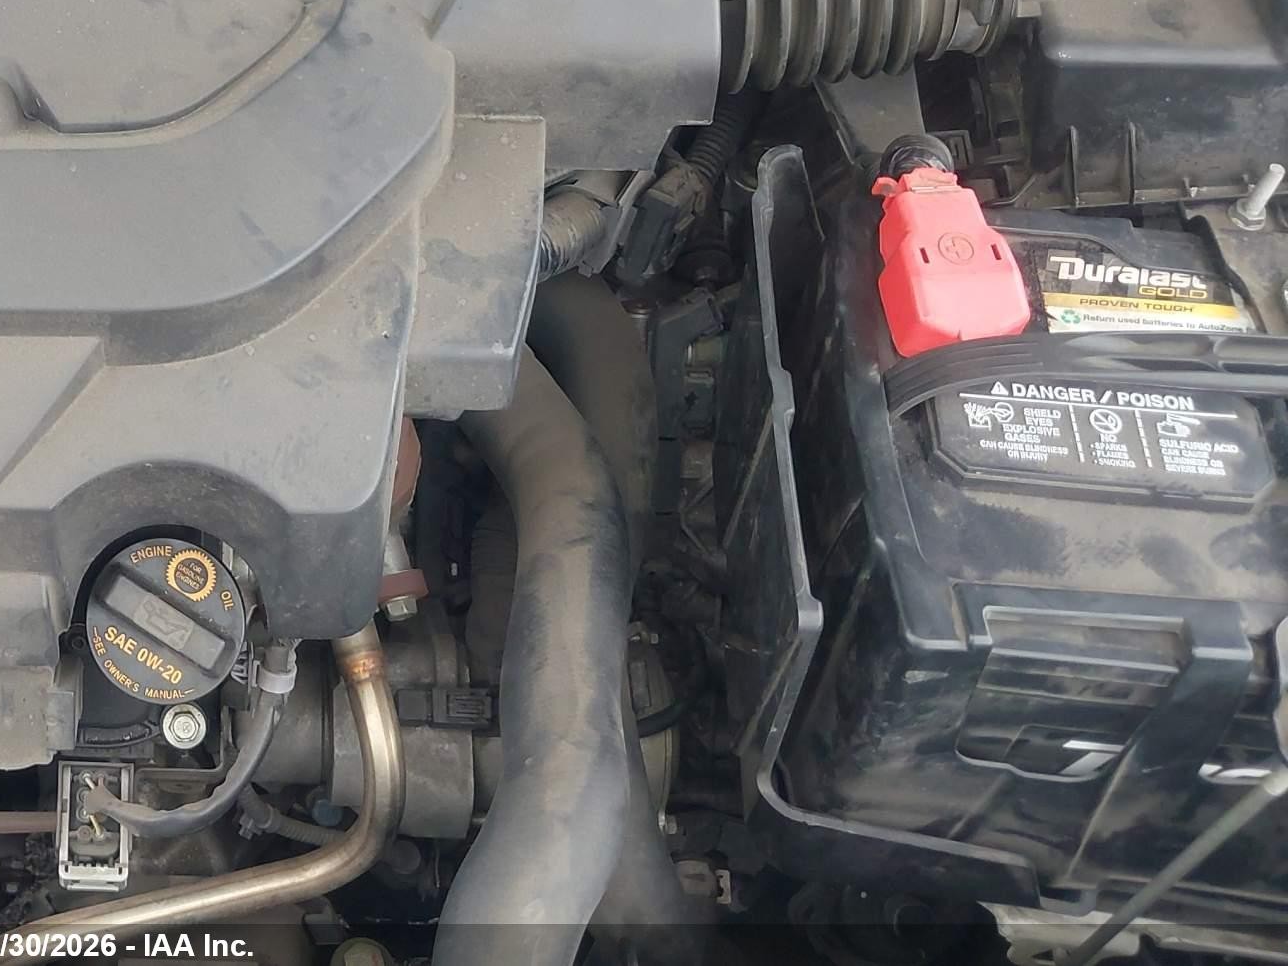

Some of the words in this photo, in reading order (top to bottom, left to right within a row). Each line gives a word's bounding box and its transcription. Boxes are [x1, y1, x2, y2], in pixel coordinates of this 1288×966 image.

[1050, 256, 1207, 289] Duralast
[1138, 286, 1208, 299] GOLD
[1080, 299, 1139, 309] PROVEN
[1144, 302, 1193, 313] TOUGH
[1083, 313, 1116, 323] Return
[1199, 322, 1244, 333] AutoZone
[1012, 383, 1097, 403] DANGER
[1117, 391, 1195, 411] POISON
[1023, 408, 1061, 419] SHIELD
[1025, 417, 1053, 427] EYES
[1002, 424, 1060, 436] EXPLOSIVE
[1004, 433, 1040, 443] GASES
[1100, 434, 1117, 442] NO
[1213, 443, 1239, 453] ACID
[130, 545, 173, 564] ENGINE
[220, 590, 235, 611] OIL
[104, 625, 138, 655] SAE
[137, 648, 183, 684] 0W-20
[103, 659, 141, 693] OWNER'S
